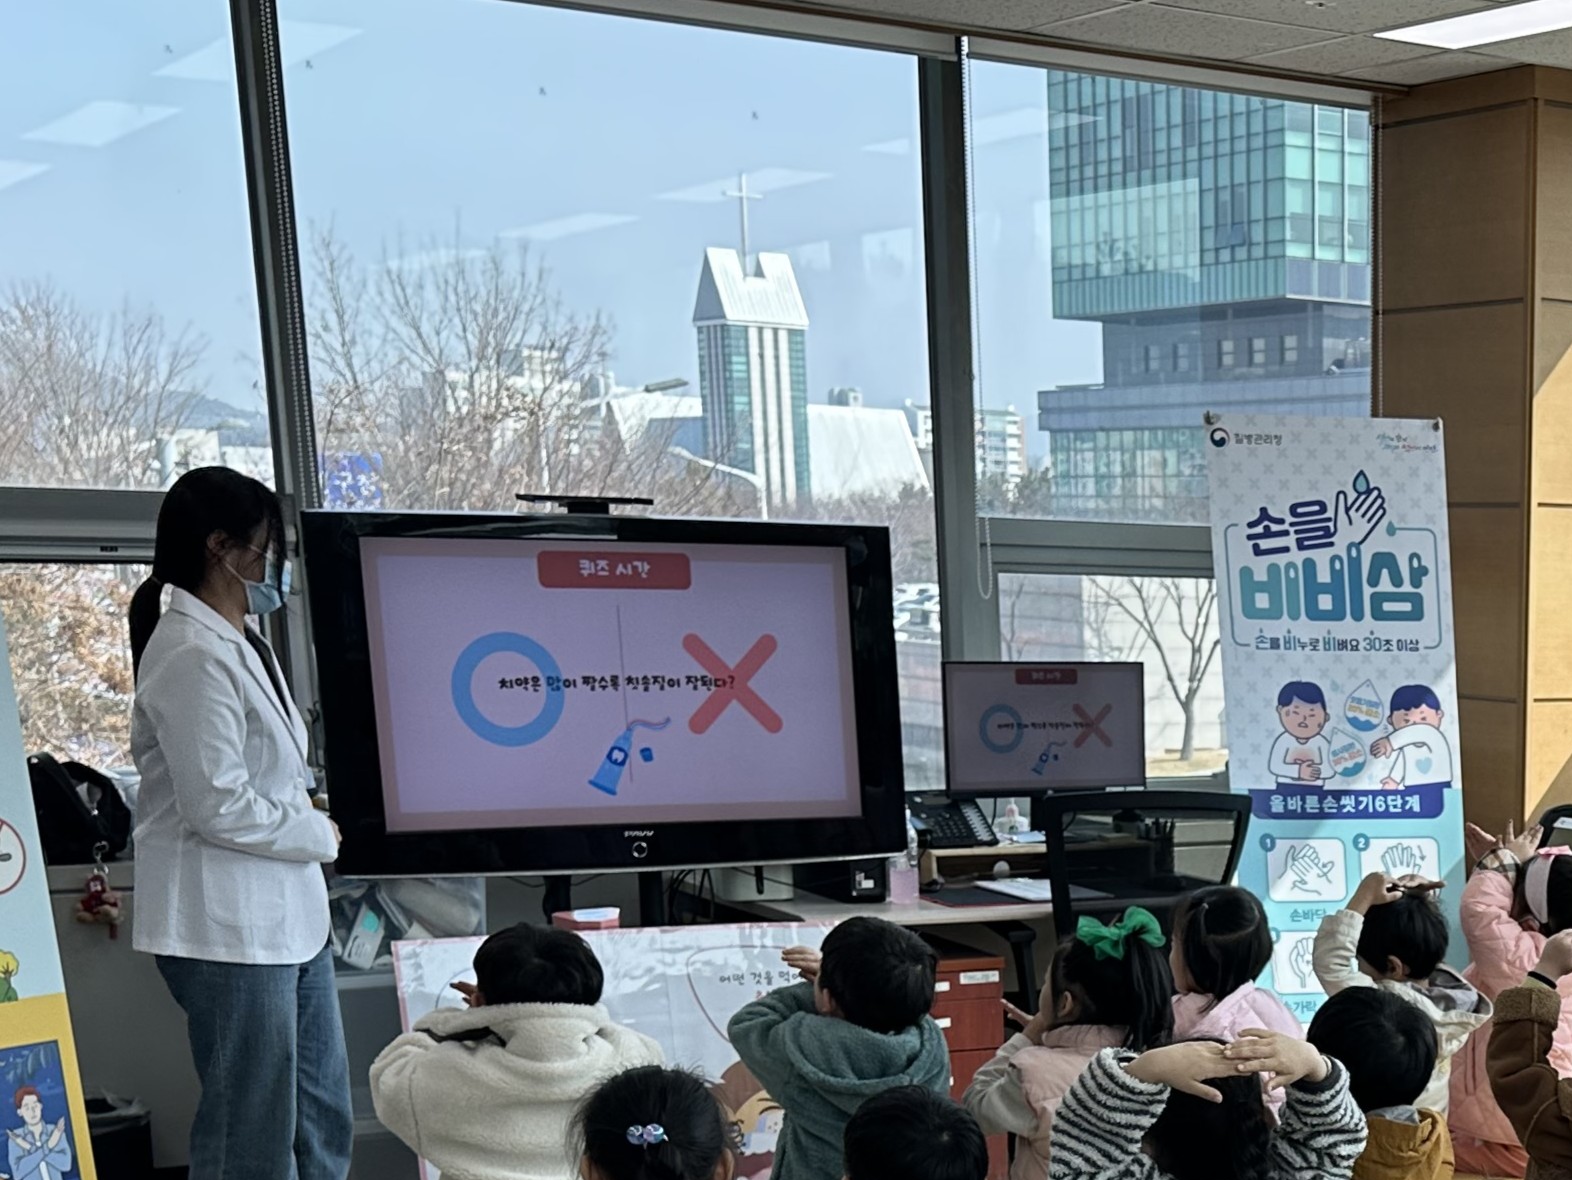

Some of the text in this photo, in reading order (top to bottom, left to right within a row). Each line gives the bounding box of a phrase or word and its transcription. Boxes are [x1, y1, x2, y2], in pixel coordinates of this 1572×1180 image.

[1233, 432, 1283, 446] 질병관리청
[1246, 500, 1336, 557] 손을
[579, 559, 651, 578] 퀴즈 시간
[1283, 634, 1320, 651] 비누로
[1323, 635, 1360, 651] 비벼요
[1396, 638, 1420, 652] 이상
[498, 675, 541, 692] 치약은
[582, 675, 620, 692] 짤수록
[625, 674, 681, 692] 칫솔질이
[1265, 838, 1272, 848] 1
[1358, 838, 1366, 848] 2
[719, 973, 744, 986] 어떤
[750, 970, 773, 986] 것을
